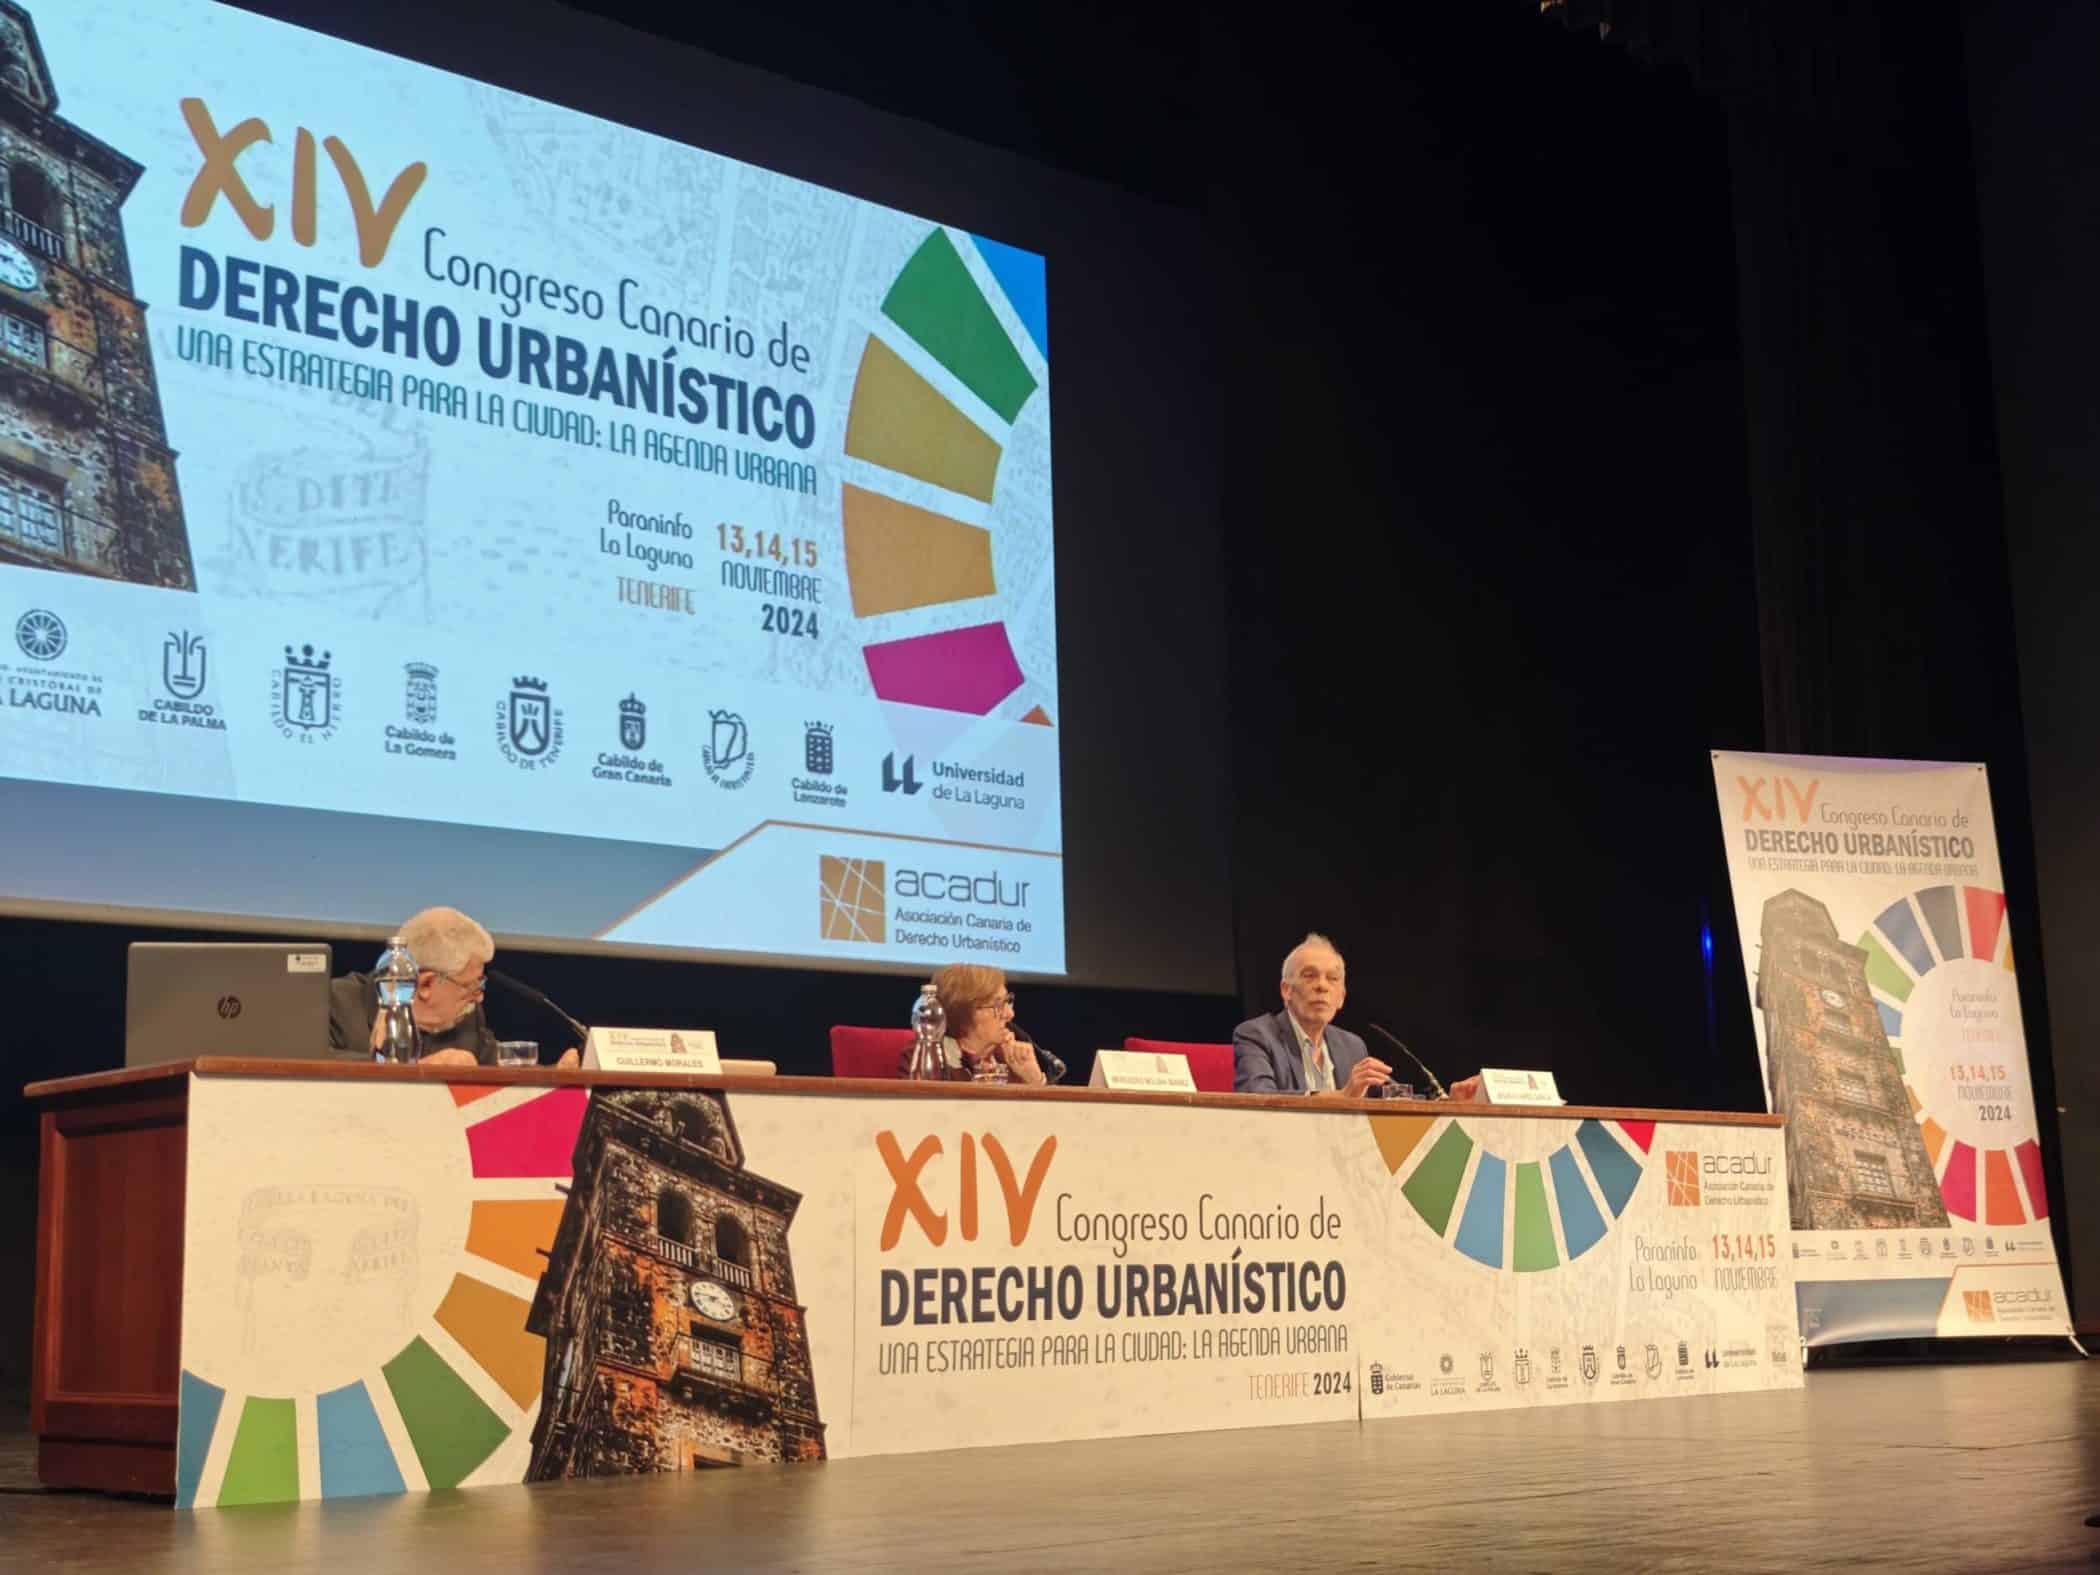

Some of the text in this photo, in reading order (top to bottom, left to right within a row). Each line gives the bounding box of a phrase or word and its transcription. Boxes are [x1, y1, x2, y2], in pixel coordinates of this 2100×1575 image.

[180, 97, 428, 268] XIV
[424, 227, 811, 373] Congreso Canario de
[179, 244, 816, 450] DERECHO URBANÍSTICO
[177, 325, 232, 371] UNA
[242, 340, 393, 404] ESTRATEGIA
[402, 374, 468, 420] PARA
[476, 391, 504, 428] LA
[513, 400, 602, 449] CIUDAD:
[610, 421, 636, 457] LA
[644, 429, 728, 477] AGENDA
[735, 448, 818, 496] URBANA
[608, 498, 693, 539] Paraninfo
[600, 527, 694, 571] La Laguna
[717, 522, 818, 568] 13,14,15
[616, 576, 696, 615] TENERIFE
[721, 560, 822, 604] NOVIEMBRE
[762, 603, 819, 639] 2024
[9, 687, 102, 718] LAGUNA
[153, 699, 214, 716] CABILDO
[138, 709, 227, 731] DE LA PALMA
[385, 724, 455, 746] Cabildo de
[384, 741, 457, 761] La Gomera
[597, 752, 664, 773] Cabildo de
[591, 765, 673, 787] Gran Canaria
[791, 776, 832, 793] Cabildo
[931, 760, 1025, 788] Universidad
[931, 783, 1025, 811] de La Laguna
[1736, 776, 1819, 824] XIV
[1820, 803, 1970, 831] Congreso Canario de
[1744, 829, 1975, 859] DERECHO URBANÍSTICO
[894, 869, 1031, 908] acadur
[895, 907, 1032, 933] Asociación Canaria de
[896, 928, 1021, 953] Derecho Urbanístico
[1978, 1104, 2012, 1121] 2024
[1703, 1151, 1773, 1175] acadur
[875, 1130, 1057, 1252] XIV
[1056, 1193, 1342, 1258] Congreso Canario de
[1634, 1235, 1698, 1262] Paraninfo
[1712, 1233, 1776, 1262] 13,14,15
[880, 1246, 1347, 1327] DERECHO URBANÍSTICO
[1629, 1266, 1698, 1299] La Laguna
[1714, 1266, 1777, 1292] NOVIEMBRE
[878, 1323, 1349, 1375] UNA ESTRATEGIA PARA LA CIUDAD: LA AGENDA URBANA
[1248, 1370, 1353, 1401] TENERIFE 2024
